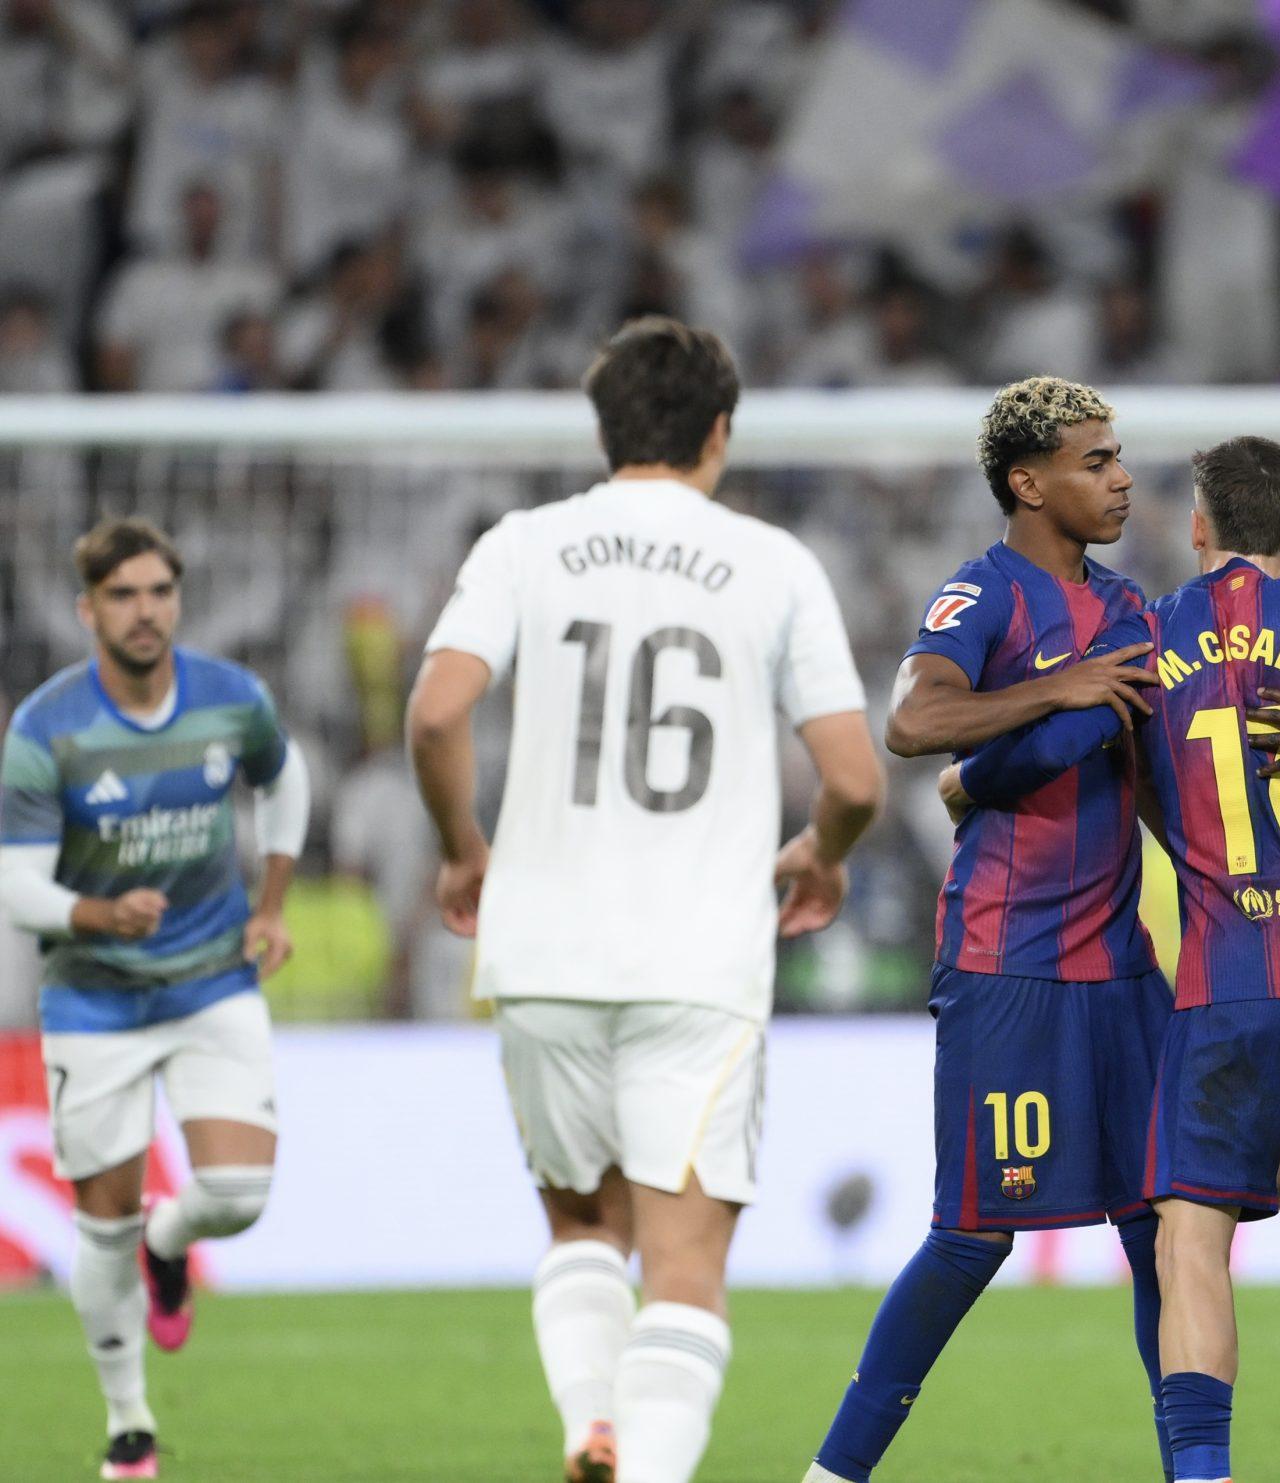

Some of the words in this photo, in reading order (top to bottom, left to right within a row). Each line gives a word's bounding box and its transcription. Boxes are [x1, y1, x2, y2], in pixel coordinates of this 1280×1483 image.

[559, 534, 733, 592] GONZALO
[1157, 649, 1202, 691] M.
[561, 619, 723, 813] 16
[984, 1090, 1051, 1160] 10
